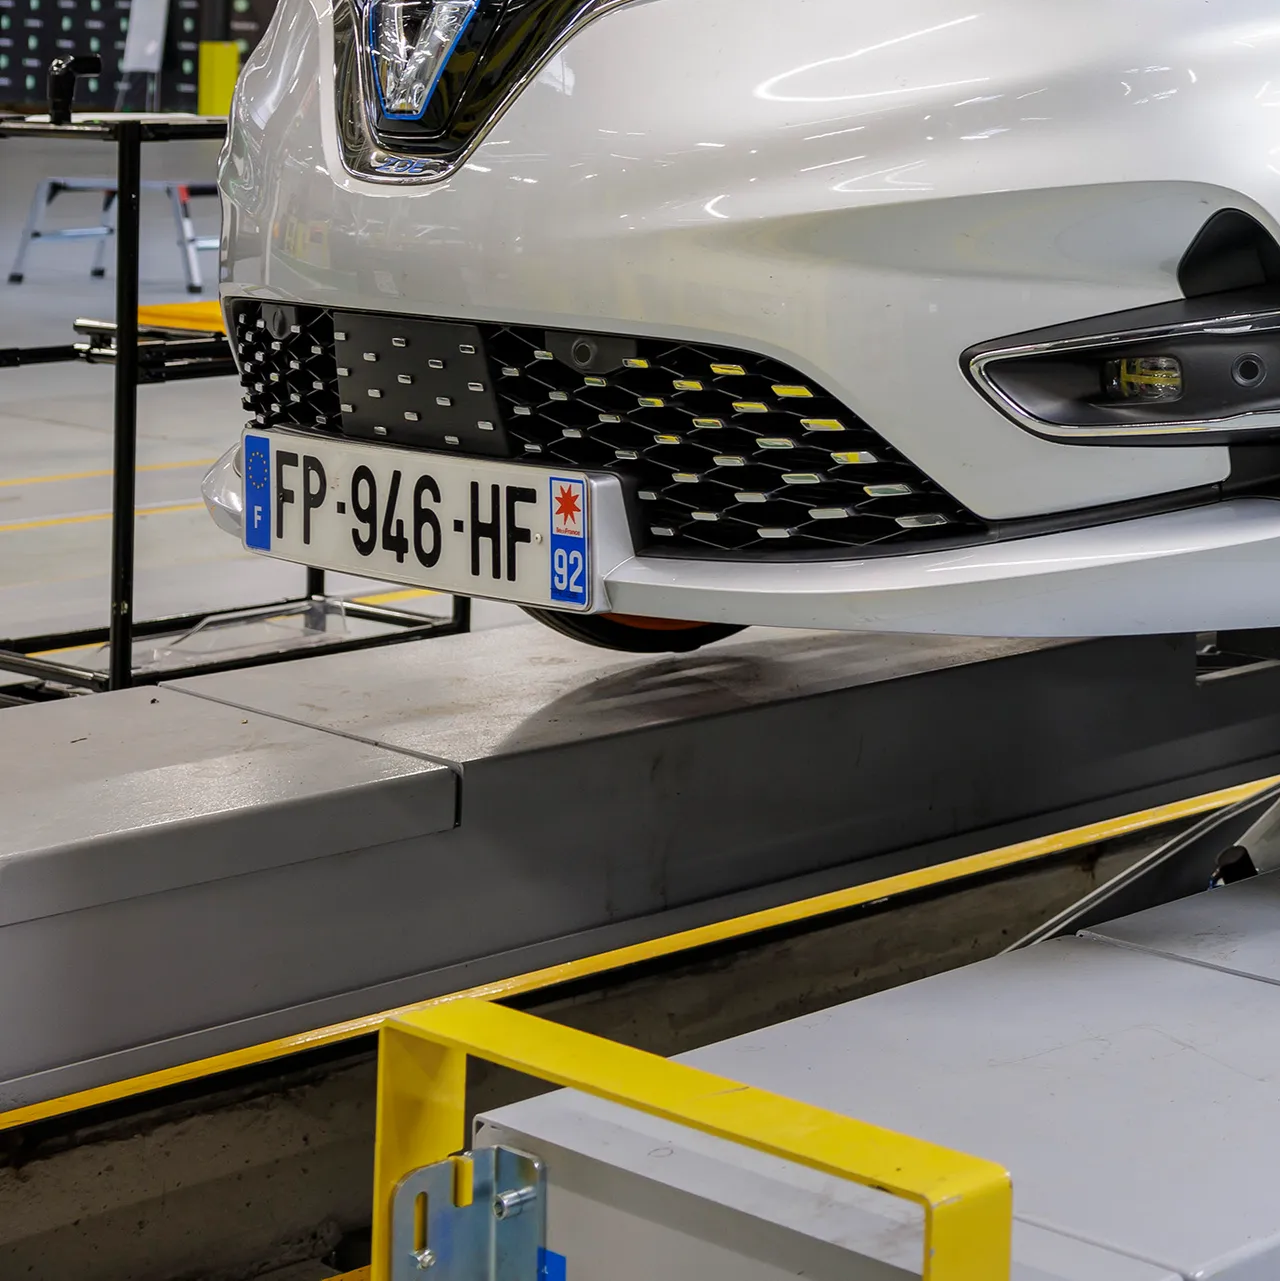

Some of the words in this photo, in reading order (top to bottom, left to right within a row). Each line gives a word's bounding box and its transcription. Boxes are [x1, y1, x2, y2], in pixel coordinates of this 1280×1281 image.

[375, 157, 431, 174] ZOE
[253, 505, 262, 529] F
[276, 450, 537, 582] FP-946-HF
[554, 548, 583, 593] 92
